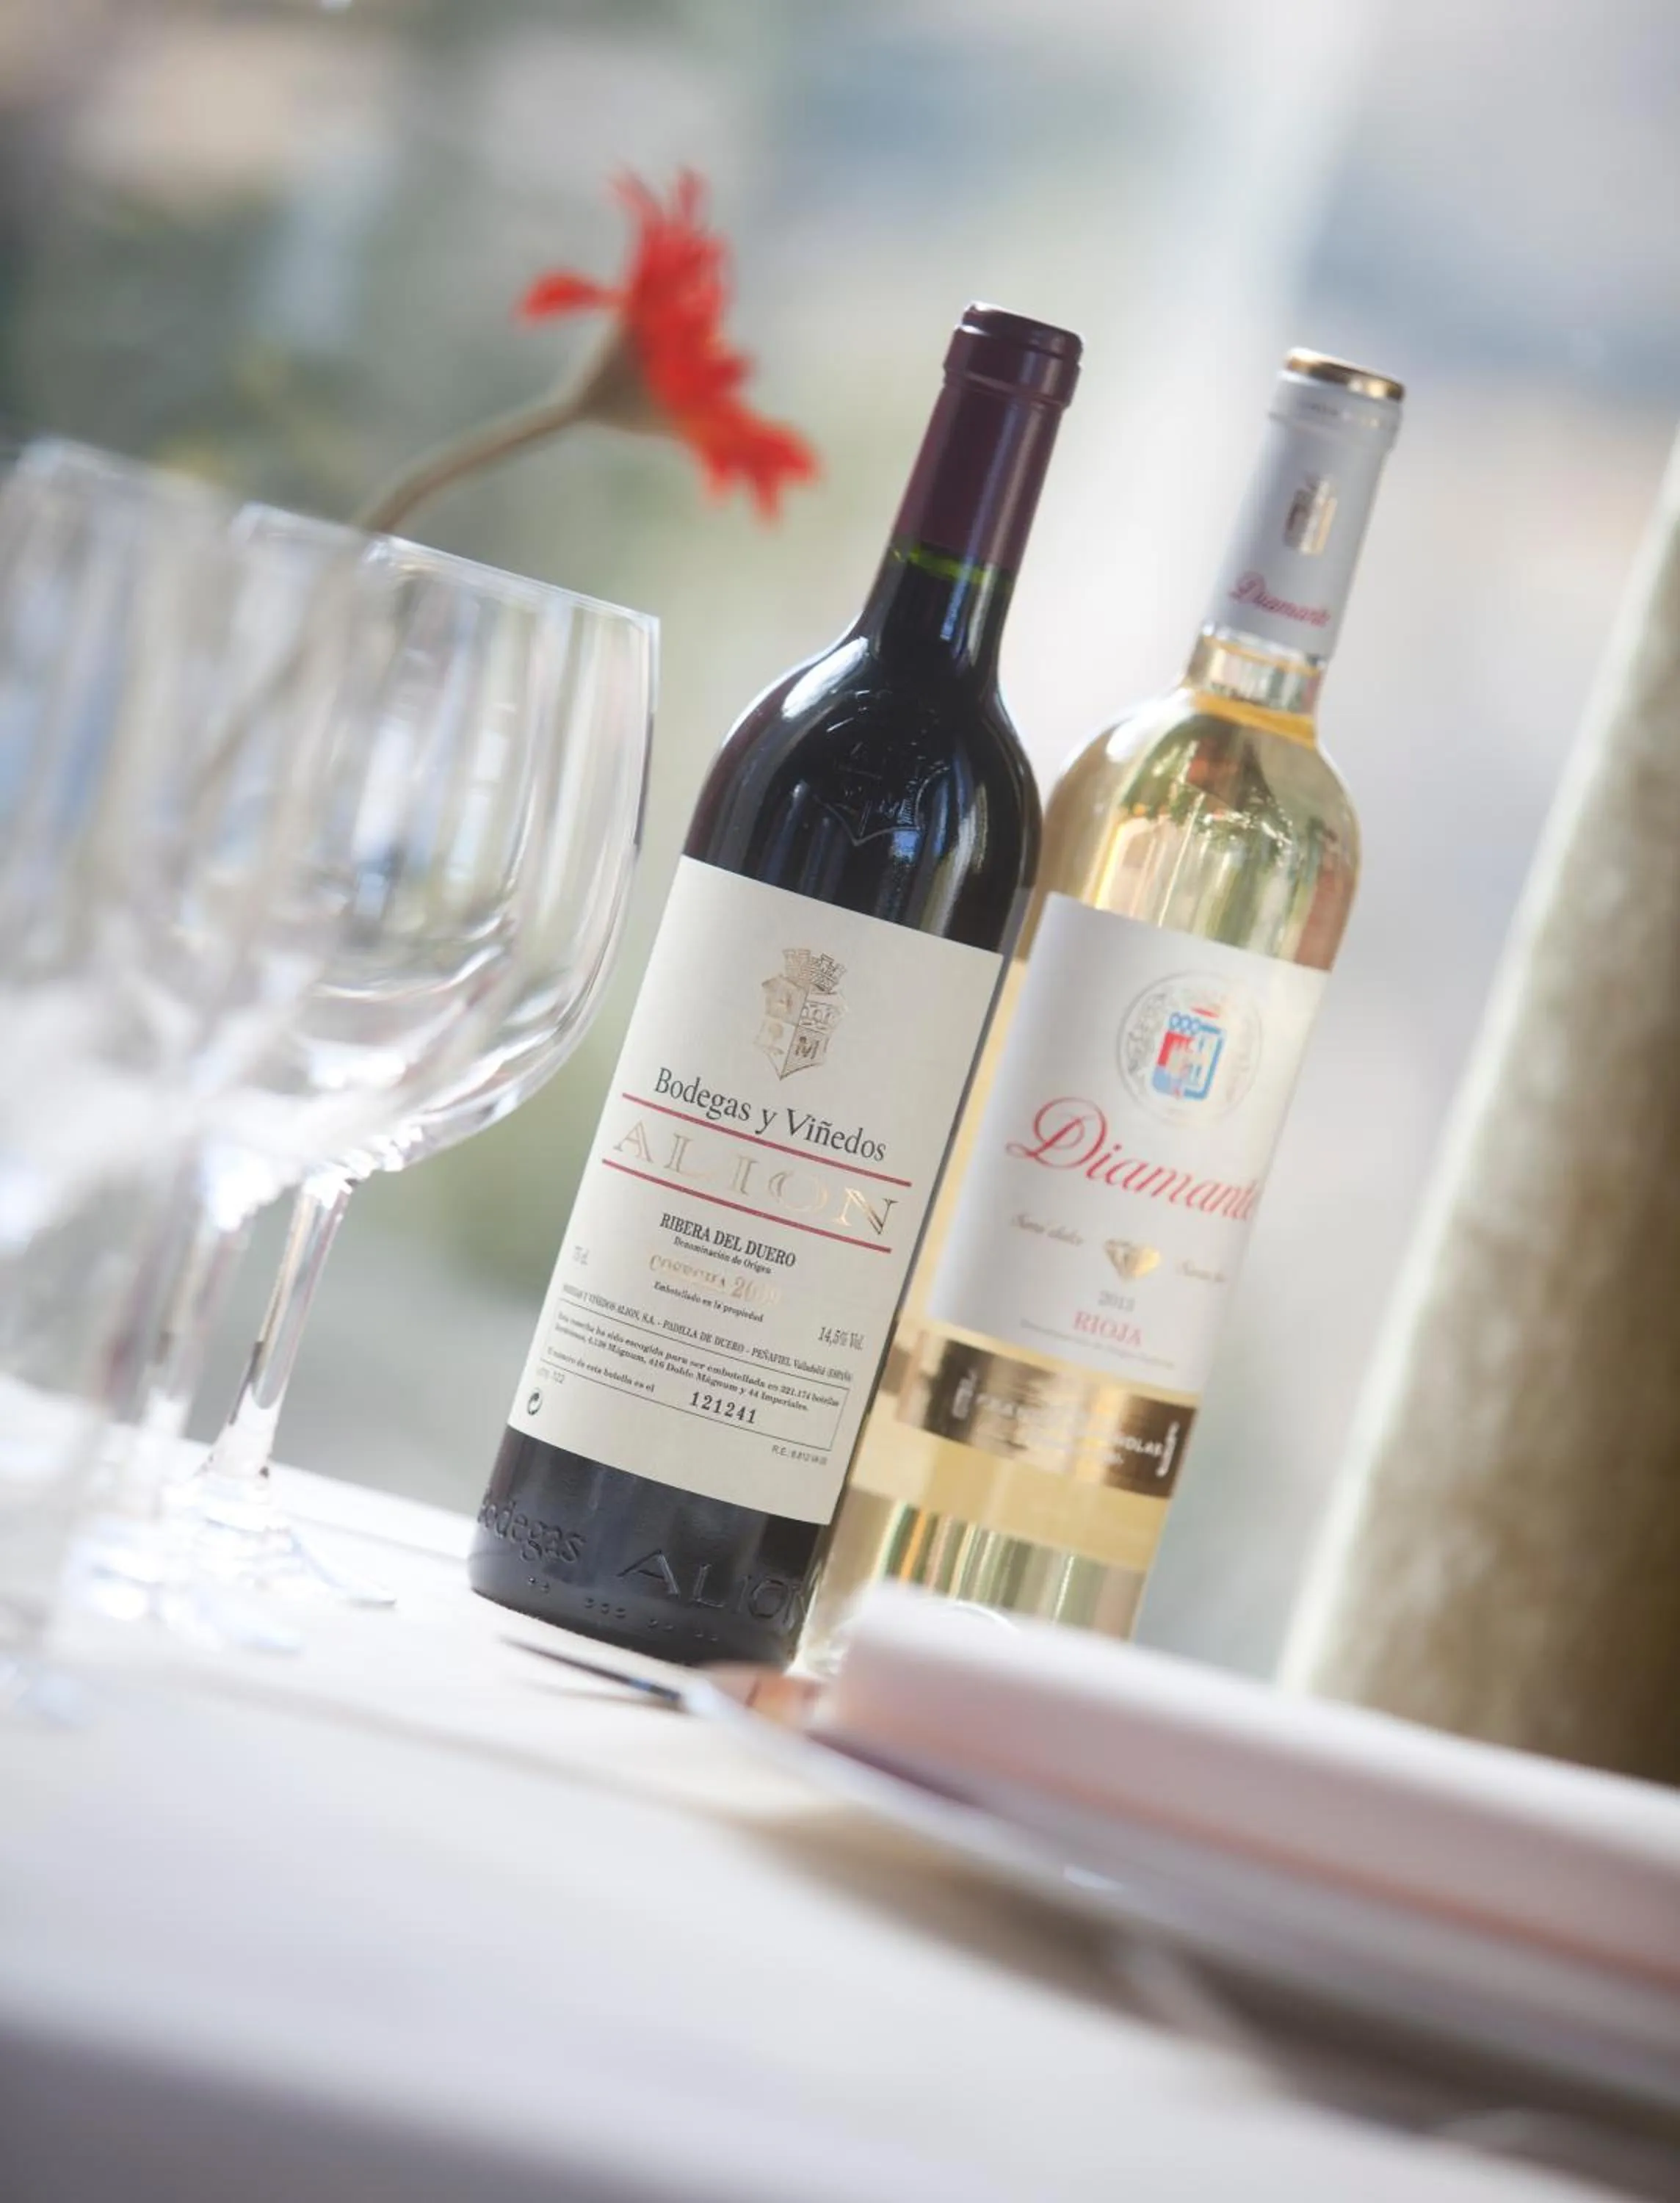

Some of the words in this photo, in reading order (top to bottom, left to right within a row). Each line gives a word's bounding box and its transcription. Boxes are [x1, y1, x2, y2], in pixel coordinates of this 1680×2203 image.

[654, 1067, 752, 1121] Bodegas
[755, 1108, 778, 1135] y
[786, 1108, 887, 1162] Viñedos
[613, 1118, 899, 1235] ALION
[659, 1212, 711, 1242] RIBERA
[713, 1230, 742, 1252] DEL
[745, 1240, 797, 1267] DUERO
[673, 1236, 731, 1262] Denominación
[731, 1254, 742, 1265] de
[743, 1258, 772, 1274] Origen
[654, 1281, 701, 1303] Embotellado
[723, 1303, 764, 1323] propiedad
[662, 1320, 698, 1339] PADILLA
[699, 1331, 713, 1344] DE
[714, 1336, 745, 1353] DUERO
[1072, 1309, 1143, 1348] RIOJA
[707, 1366, 766, 1389] embotellada
[690, 1392, 757, 1424] 121241
[478, 1488, 587, 1564] odegas
